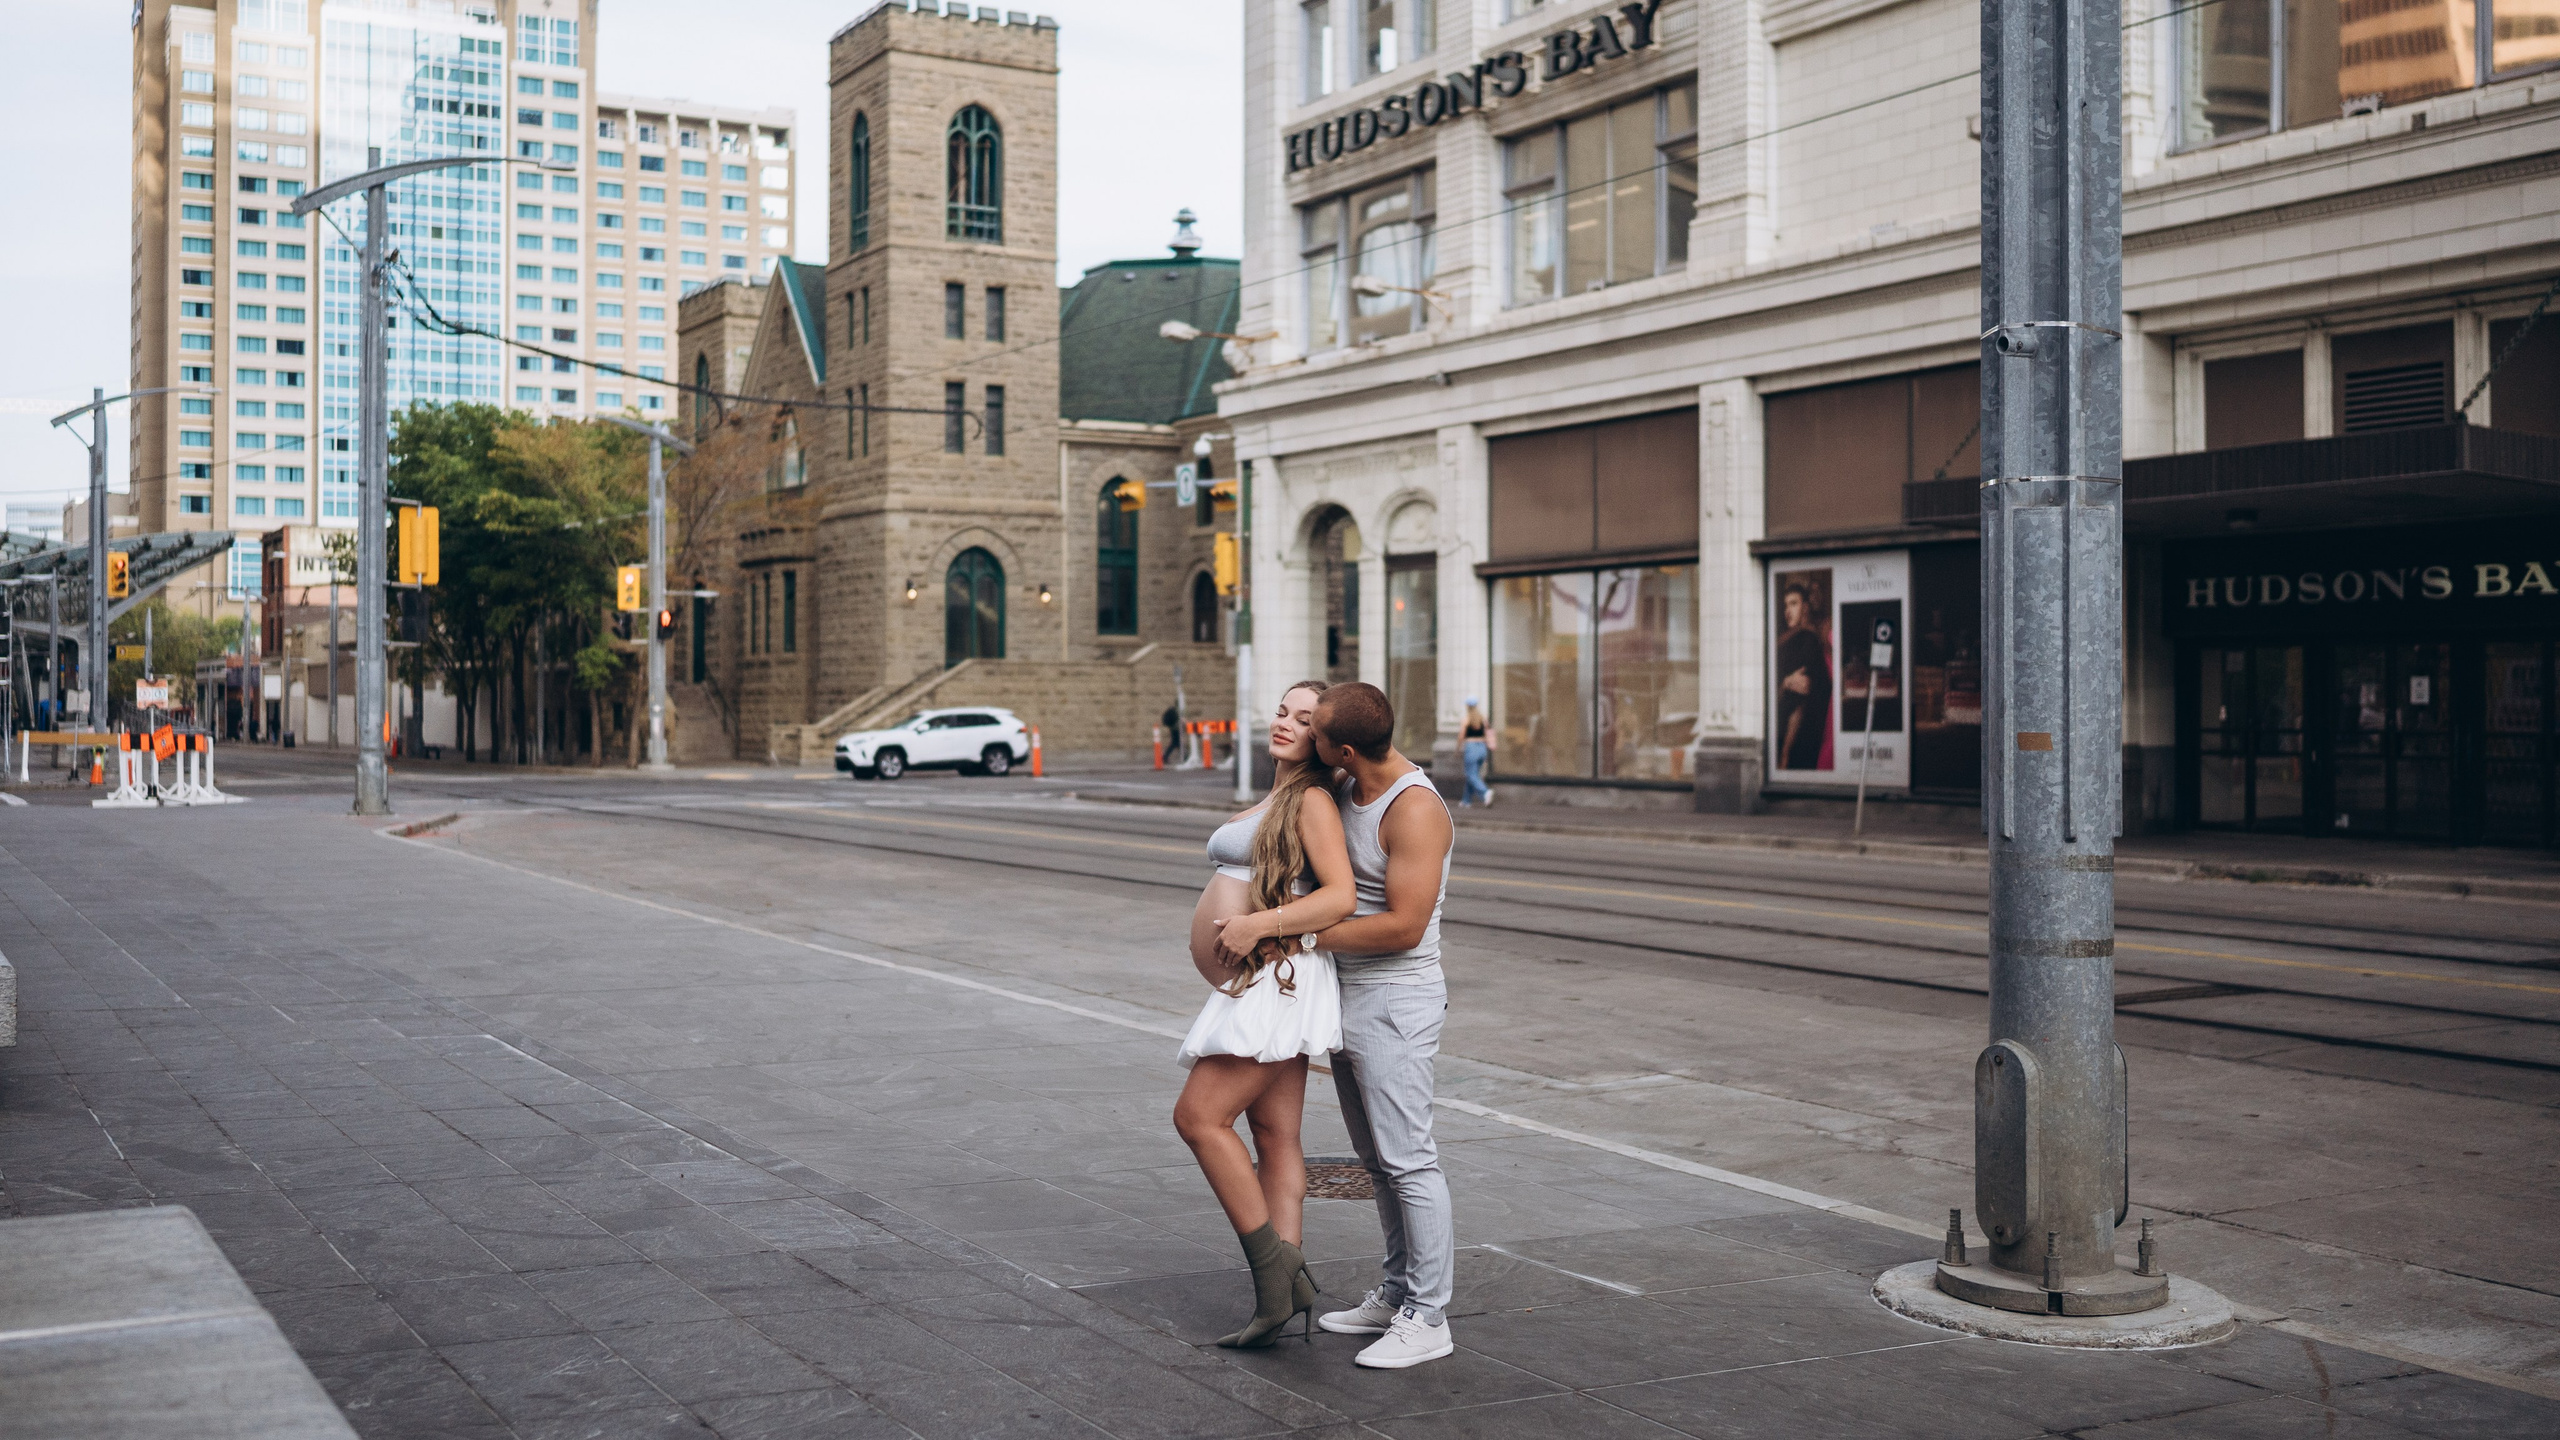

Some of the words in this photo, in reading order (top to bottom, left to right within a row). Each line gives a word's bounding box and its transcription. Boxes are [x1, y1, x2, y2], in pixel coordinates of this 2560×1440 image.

[1284, 51, 1526, 174] HUDSON'S
[1542, 0, 1663, 81] BAY
[2185, 566, 2453, 608] HUDSON'S
[2473, 560, 2560, 597] BA
